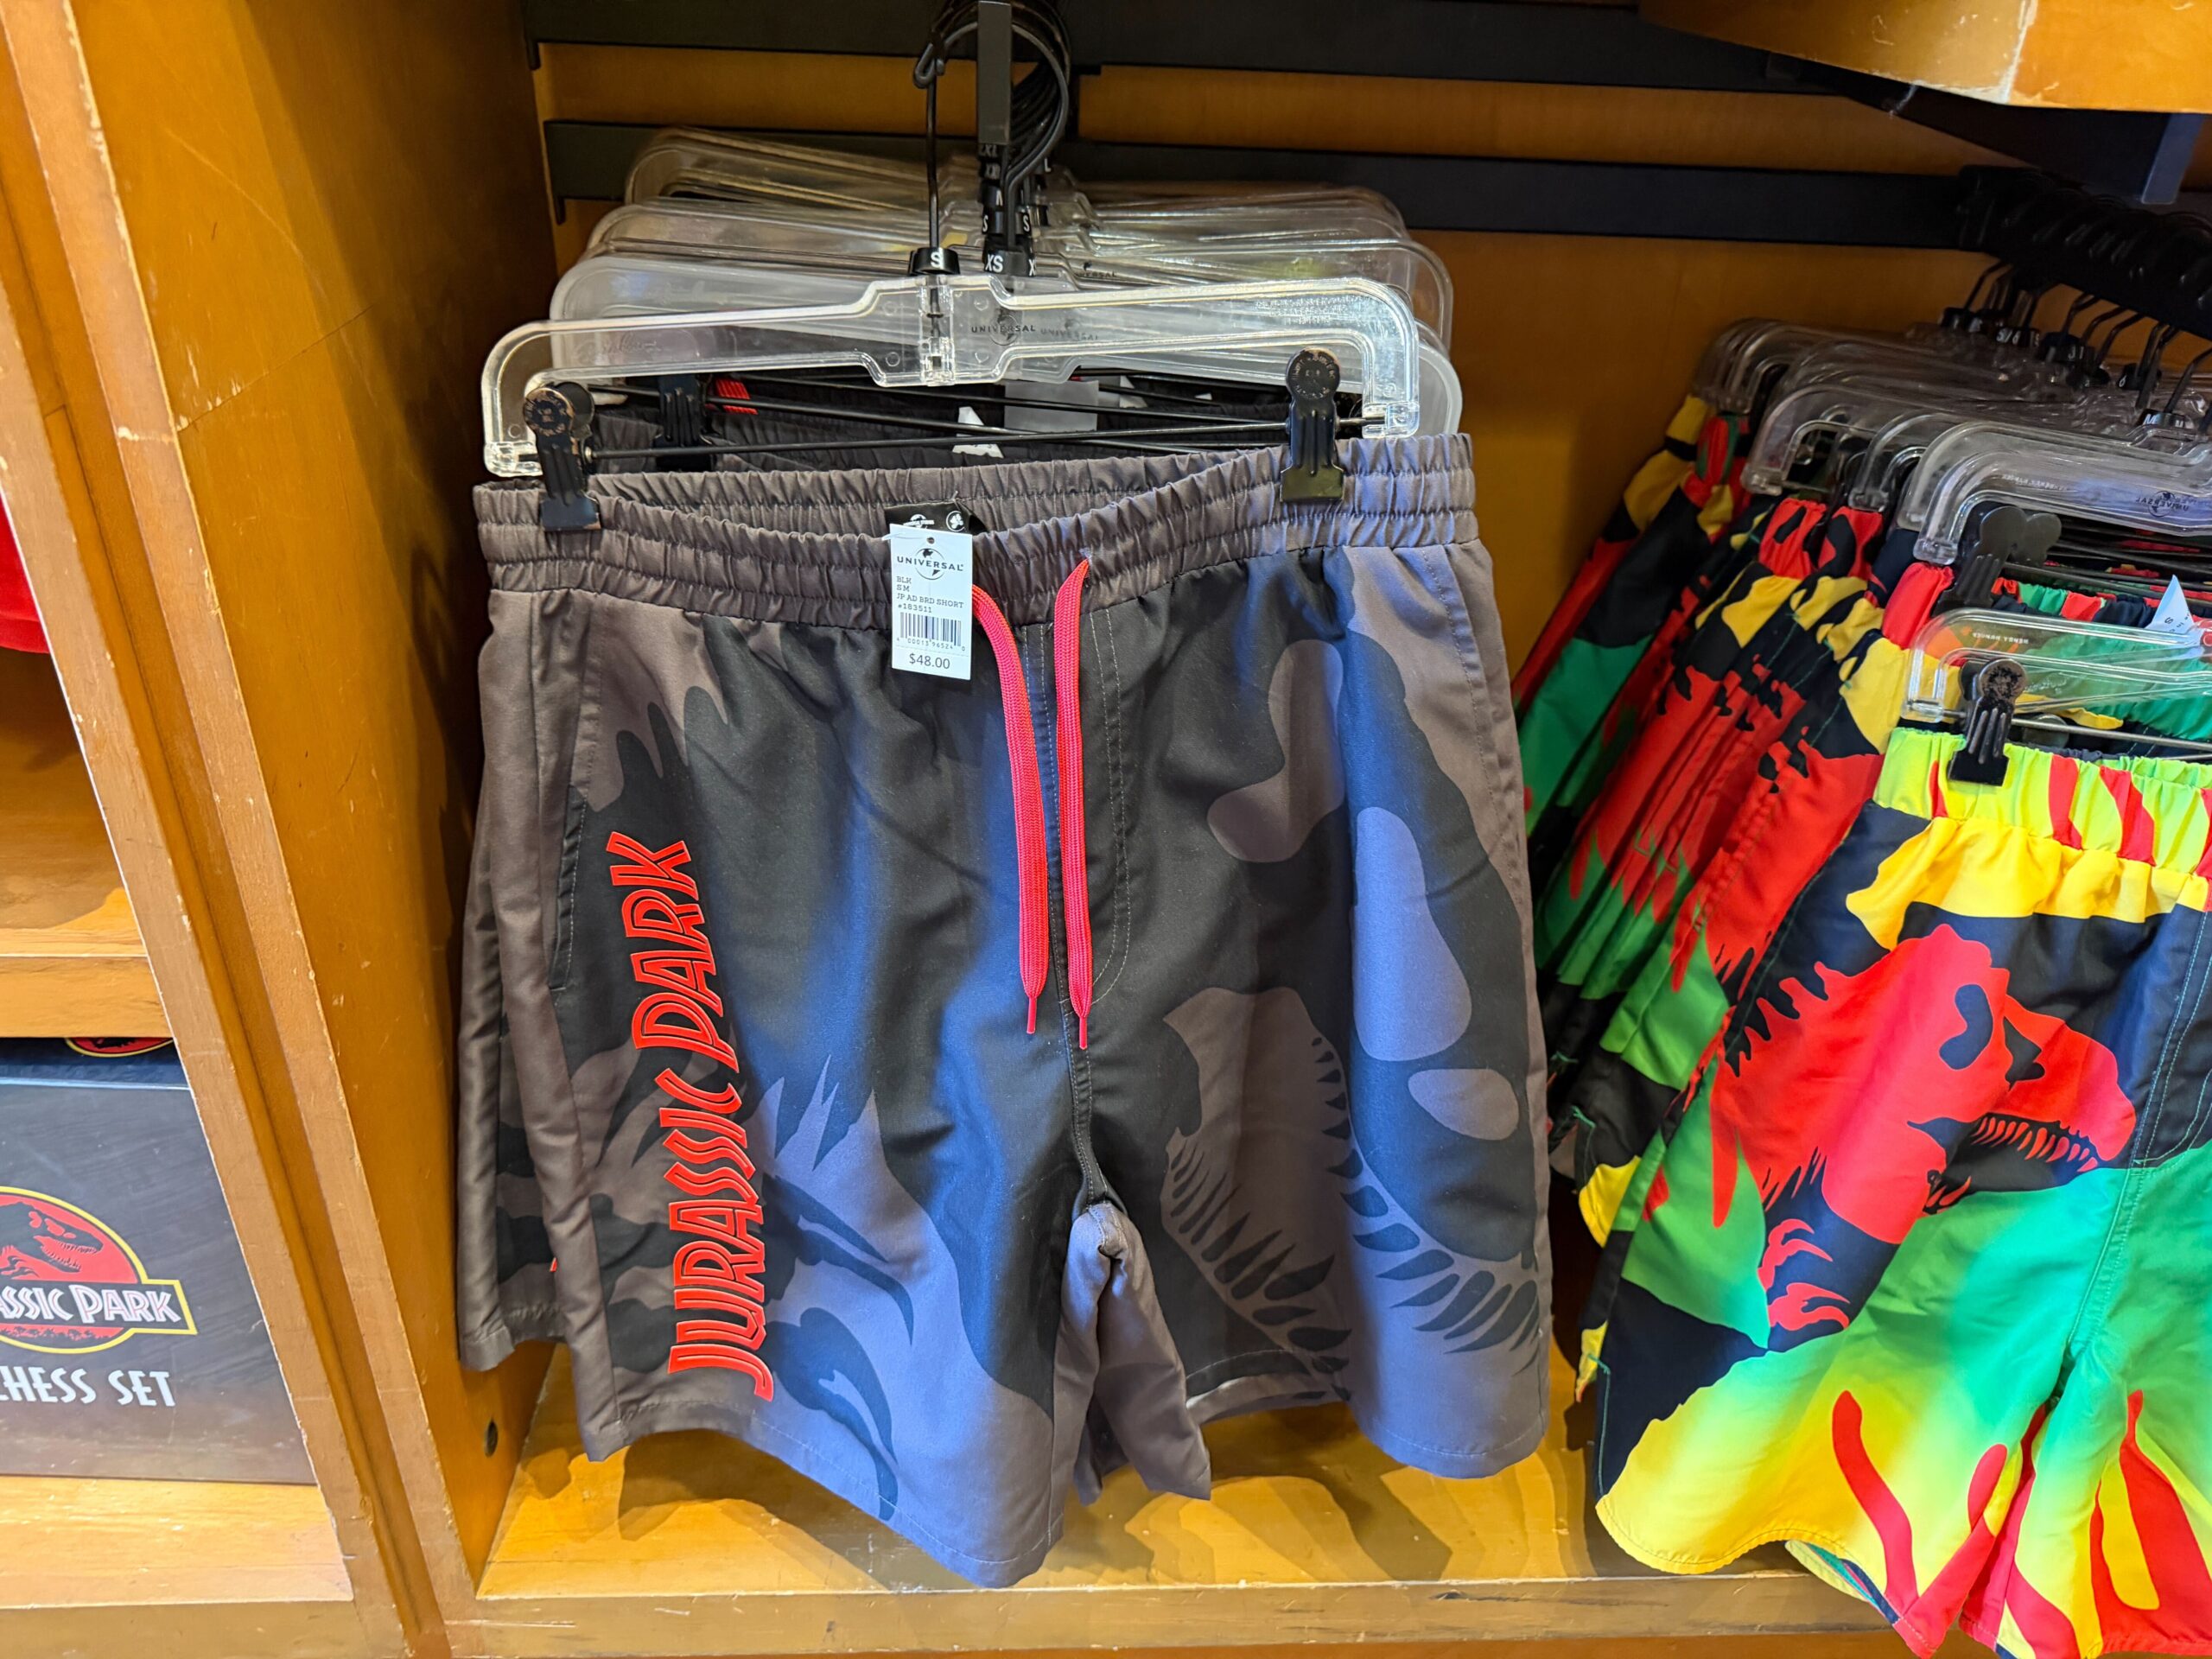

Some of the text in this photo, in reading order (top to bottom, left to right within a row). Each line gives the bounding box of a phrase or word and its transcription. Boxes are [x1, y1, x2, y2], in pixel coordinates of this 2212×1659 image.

[930, 251, 944, 268] S
[985, 254, 1004, 273] XS
[971, 324, 1036, 334] UNIVERSAL
[897, 556, 963, 572] UNIVERSAL
[896, 575, 912, 585] BLK
[919, 596, 935, 605] BRD
[936, 599, 964, 609] SHORT
[909, 653, 950, 670] $48.00
[607, 830, 774, 1403] JURASSIC PARK
[68, 1284, 181, 1324] PARK
[0, 1365, 176, 1407] HESS SET
